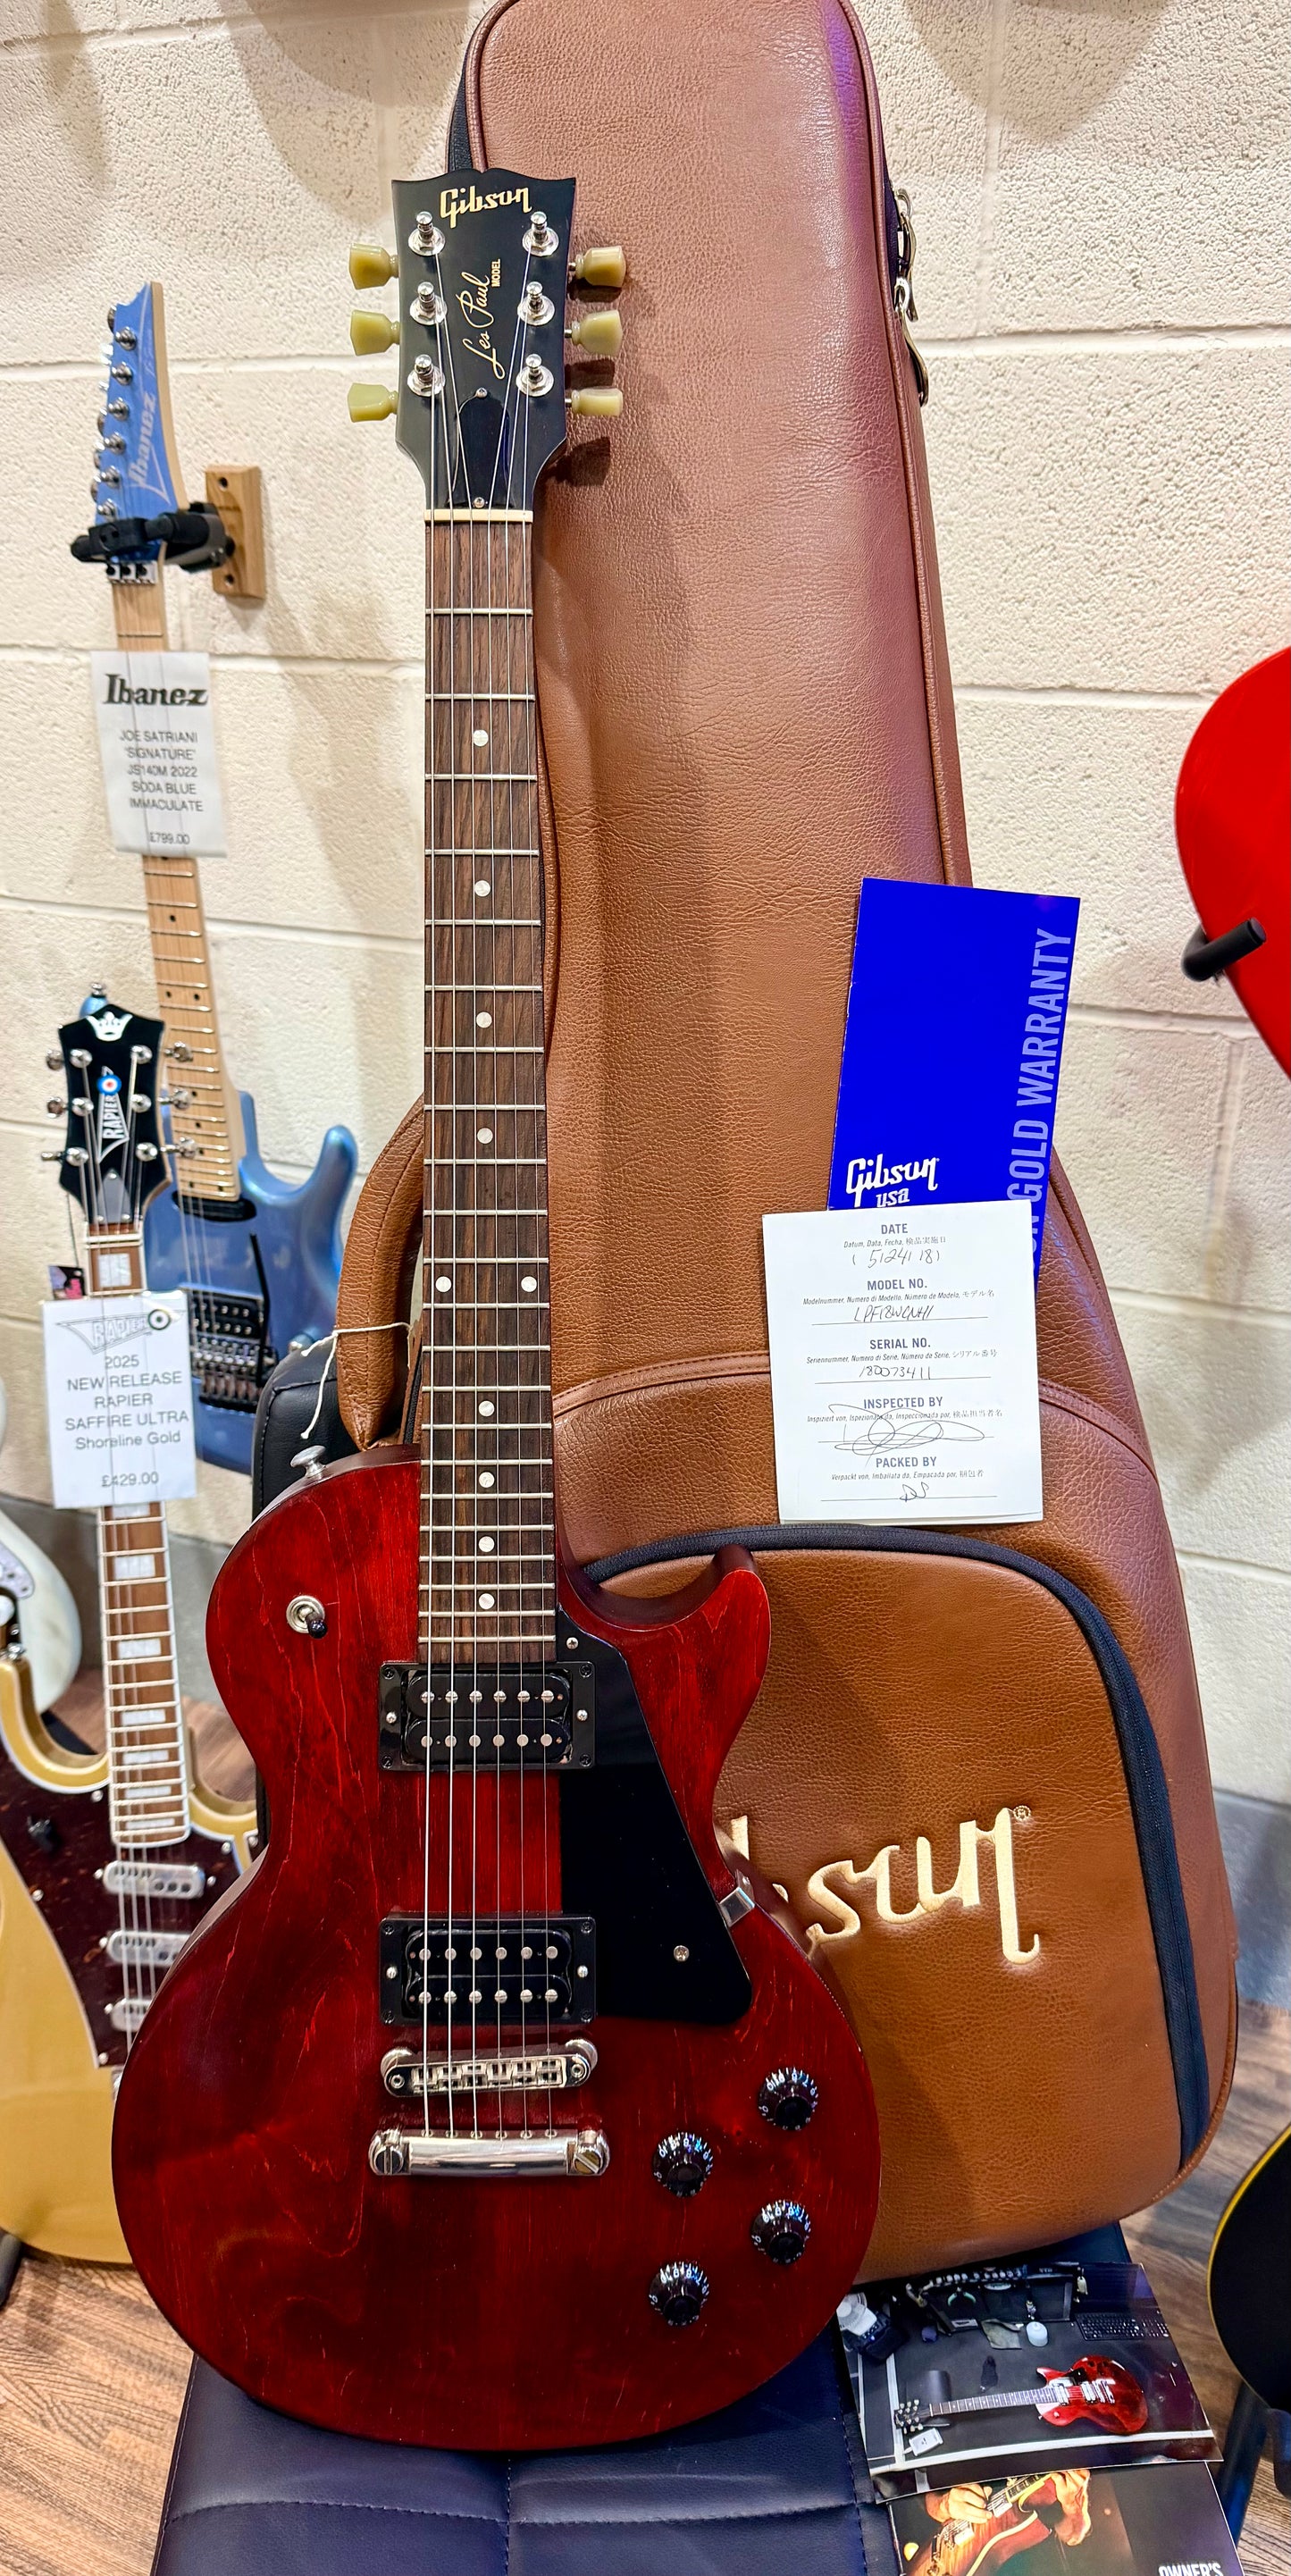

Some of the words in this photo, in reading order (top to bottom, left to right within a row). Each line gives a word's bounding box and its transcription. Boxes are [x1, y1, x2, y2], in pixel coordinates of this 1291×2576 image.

[440, 186, 532, 229] Gibson
[491, 259, 501, 287] MODEL
[456, 272, 494, 329] Paul
[463, 331, 506, 380] Les
[129, 391, 156, 487] Ibanez
[103, 674, 207, 706] Ibanez
[120, 730, 141, 741] JOE
[143, 730, 197, 743] SATRIANI
[171, 766, 197, 777] 2022
[131, 782, 163, 793] SODA
[166, 783, 197, 794] BLUE
[129, 798, 204, 812] IMMACULATE
[1016, 927, 1071, 1106] WARRANTY
[103, 1095, 125, 1138] RAPIER
[1007, 1119, 1049, 1202] GOLD
[846, 1154, 938, 1207] Gibson
[876, 1187, 910, 1207] usa
[881, 1223, 908, 1234] DATE
[868, 1280, 904, 1290] MODEL
[909, 1278, 927, 1288] NO.
[870, 1339, 908, 1349] SERIAL
[912, 1338, 930, 1347] NO.
[105, 1355, 139, 1369] 2025
[67, 1377, 105, 1391] NEW
[110, 1372, 182, 1388] RELEASE
[95, 1393, 153, 1408] RAPIER
[864, 1397, 924, 1409] INSPECTED
[928, 1397, 943, 1406] BY
[65, 1414, 131, 1431] SAFFIRE
[137, 1411, 189, 1425] ULTRA
[76, 1434, 142, 1450] Shoreline
[147, 1431, 180, 1445] Gold
[876, 1457, 918, 1468] PACKED
[923, 1456, 937, 1466] BY
[101, 1472, 159, 1488] £429.00
